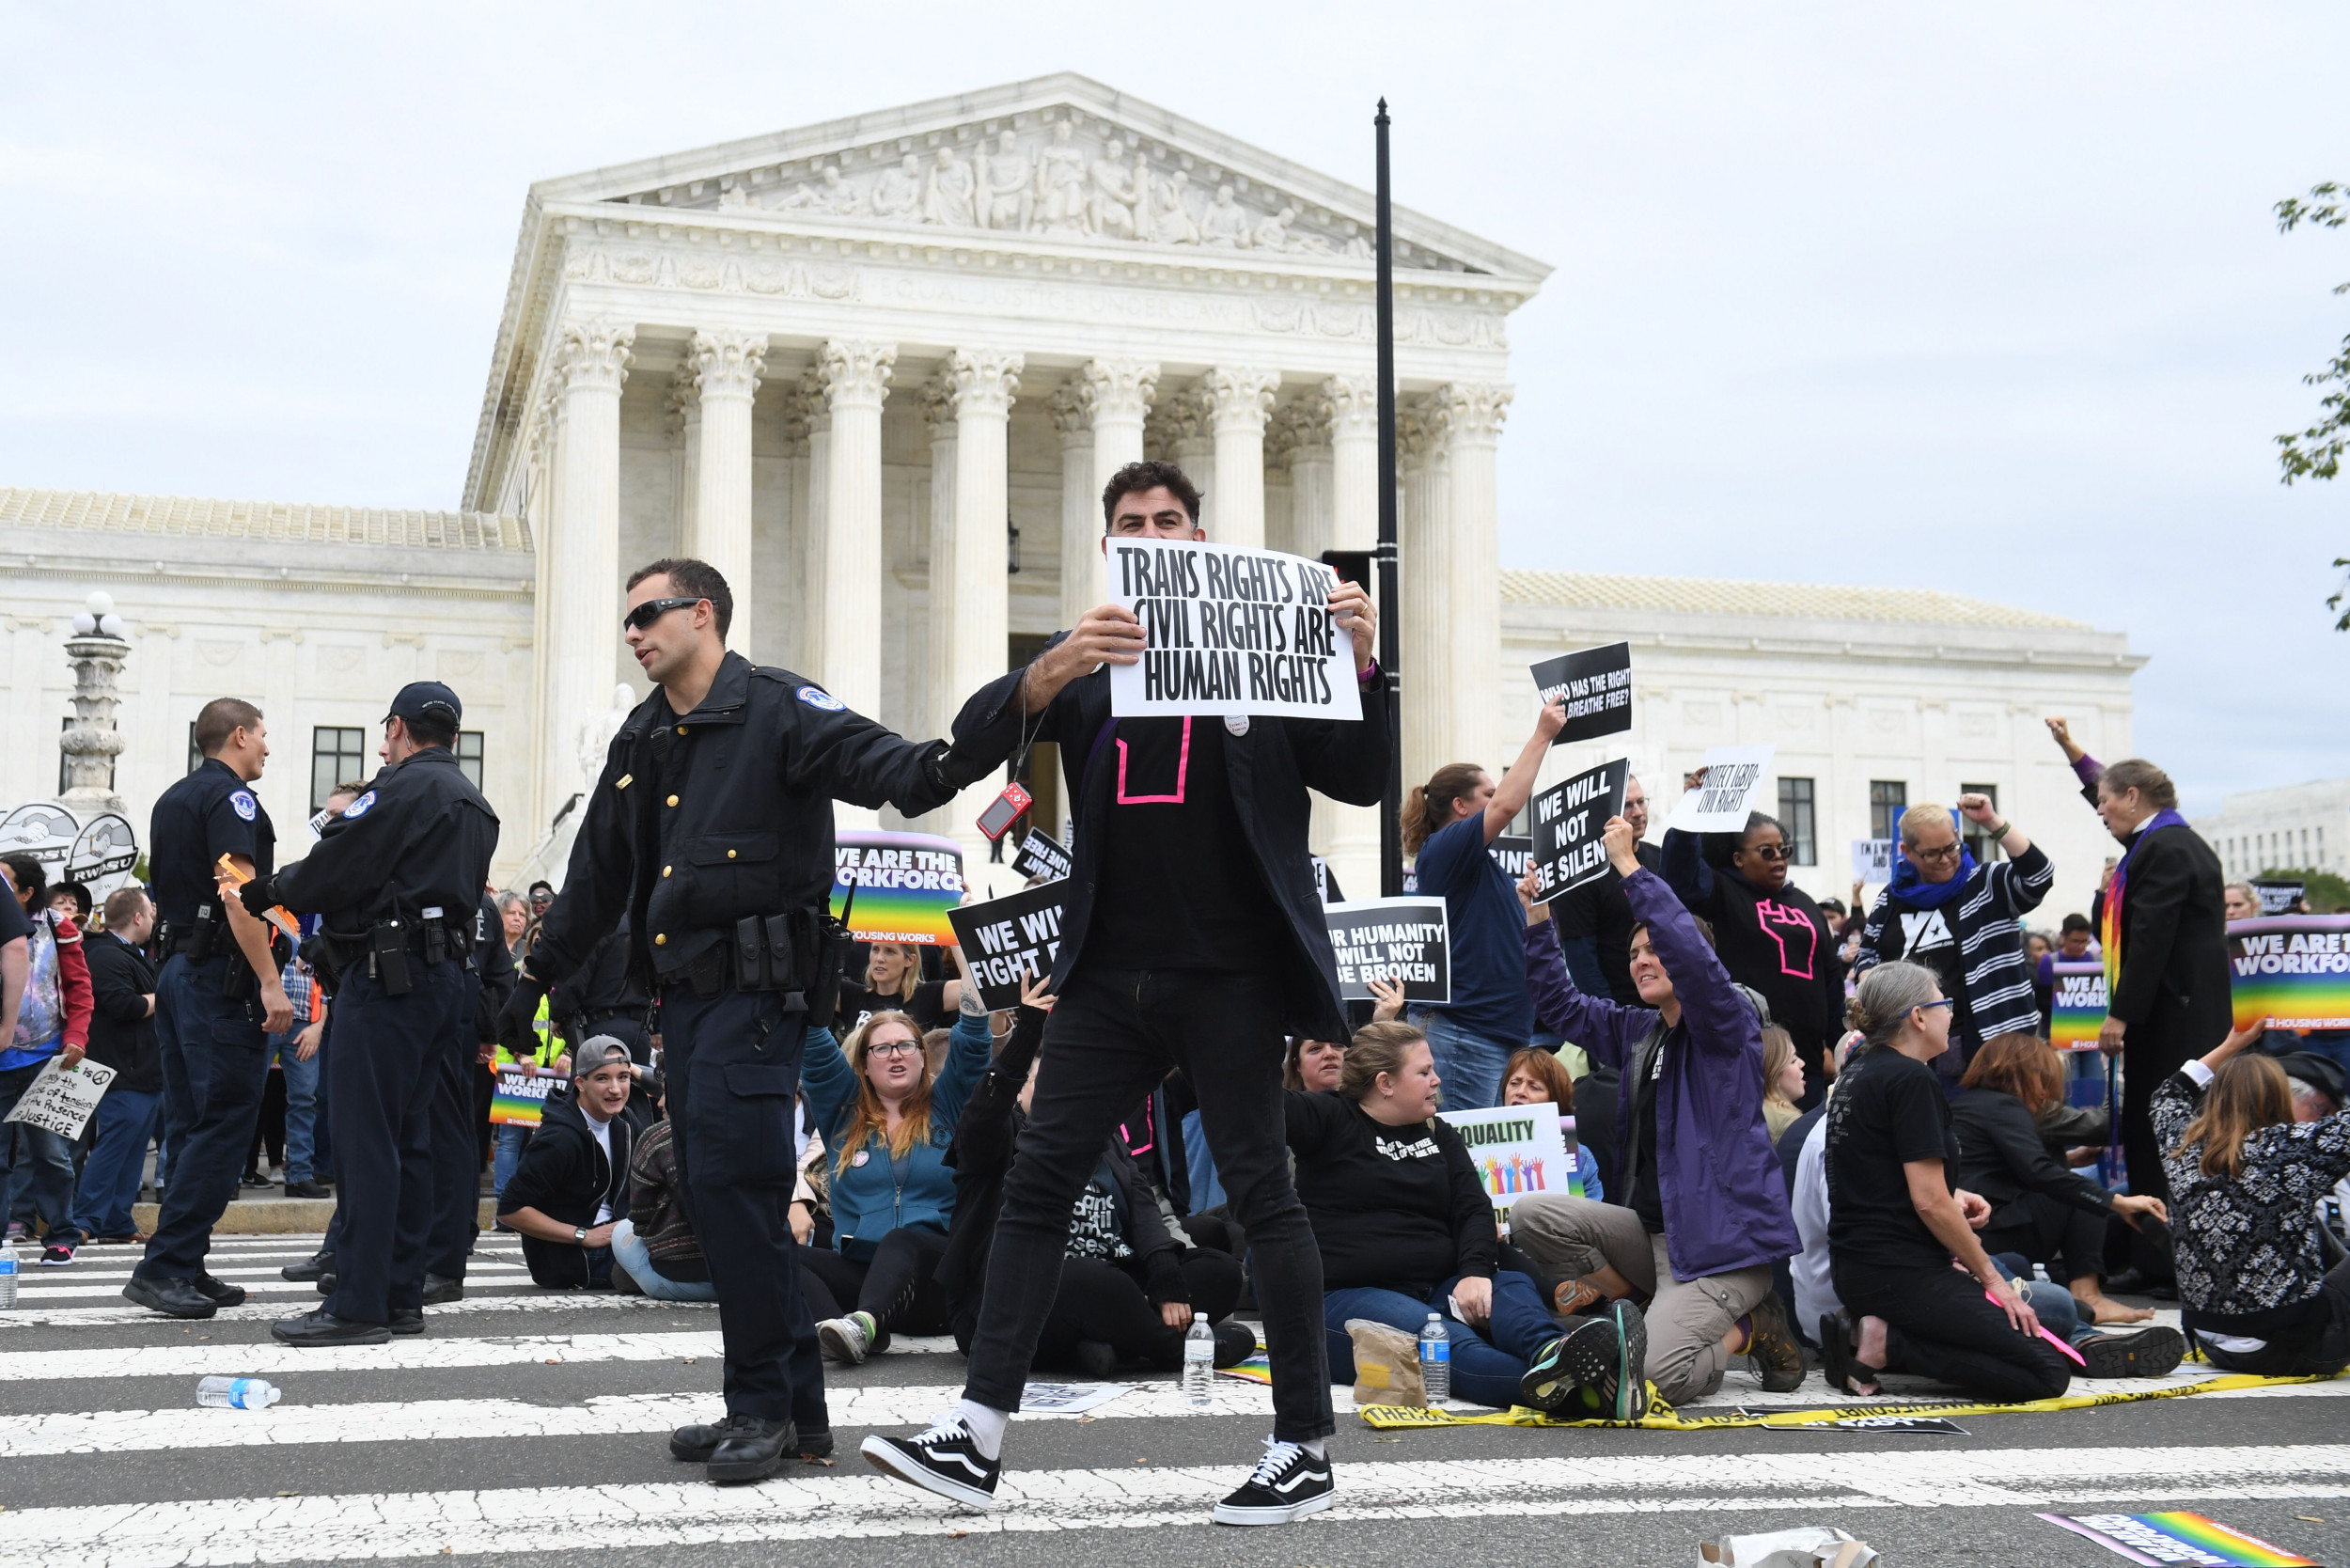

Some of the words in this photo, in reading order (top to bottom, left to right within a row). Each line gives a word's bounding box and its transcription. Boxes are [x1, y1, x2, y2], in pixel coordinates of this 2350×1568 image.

[882, 278, 969, 303] EQUAL
[976, 284, 1076, 311] JUSTICE
[1088, 293, 1173, 317] UNDER
[1182, 301, 1231, 321] LAW
[1117, 547, 1199, 598] TRANS
[1205, 553, 1292, 604] RIGHTS
[1199, 600, 1287, 652] RIGHTS
[1294, 606, 1336, 656] ARE
[1145, 651, 1241, 701] HUMAN
[1247, 652, 1332, 705] RIGHTS
[1571, 679, 1590, 698] HAS
[1590, 673, 1606, 694] THE
[1607, 667, 1631, 690] RIGHT
[1567, 695, 1604, 719] BREATHE
[1606, 688, 1629, 710] FREE?
[1539, 791, 1562, 824] WE
[1566, 771, 1610, 810] WILL
[1697, 789, 1719, 813] CIVIL
[1715, 789, 1748, 812] RIGHTS
[1555, 809, 1589, 850] NOT
[1024, 836, 1050, 860] FREE
[1558, 838, 1606, 882] SILEN
[73, 857, 132, 882] RWDSU
[863, 849, 912, 870] ARE
[916, 851, 957, 872] THE
[836, 867, 964, 892] ORKFORCE
[897, 933, 935, 943] WORKS
[975, 920, 1019, 954] WE
[1351, 923, 1444, 946] HUMANITY
[2241, 934, 2284, 955] WE
[2288, 933, 2341, 953] ARE
[1335, 945, 1385, 965] WILL
[1387, 943, 1424, 962] NOT
[2233, 953, 2350, 977] WORKFO
[968, 948, 1041, 990] FIGHT
[1359, 963, 1436, 983] BROKEN
[2062, 976, 2091, 992] WE
[2277, 1018, 2323, 1027] HOUSING
[504, 1073, 526, 1087] WE
[526, 1077, 554, 1090] ARE
[1455, 1120, 1534, 1148] QUALITY
[2098, 1529, 2163, 1547] ARE
[2136, 1546, 2191, 1561] WE
